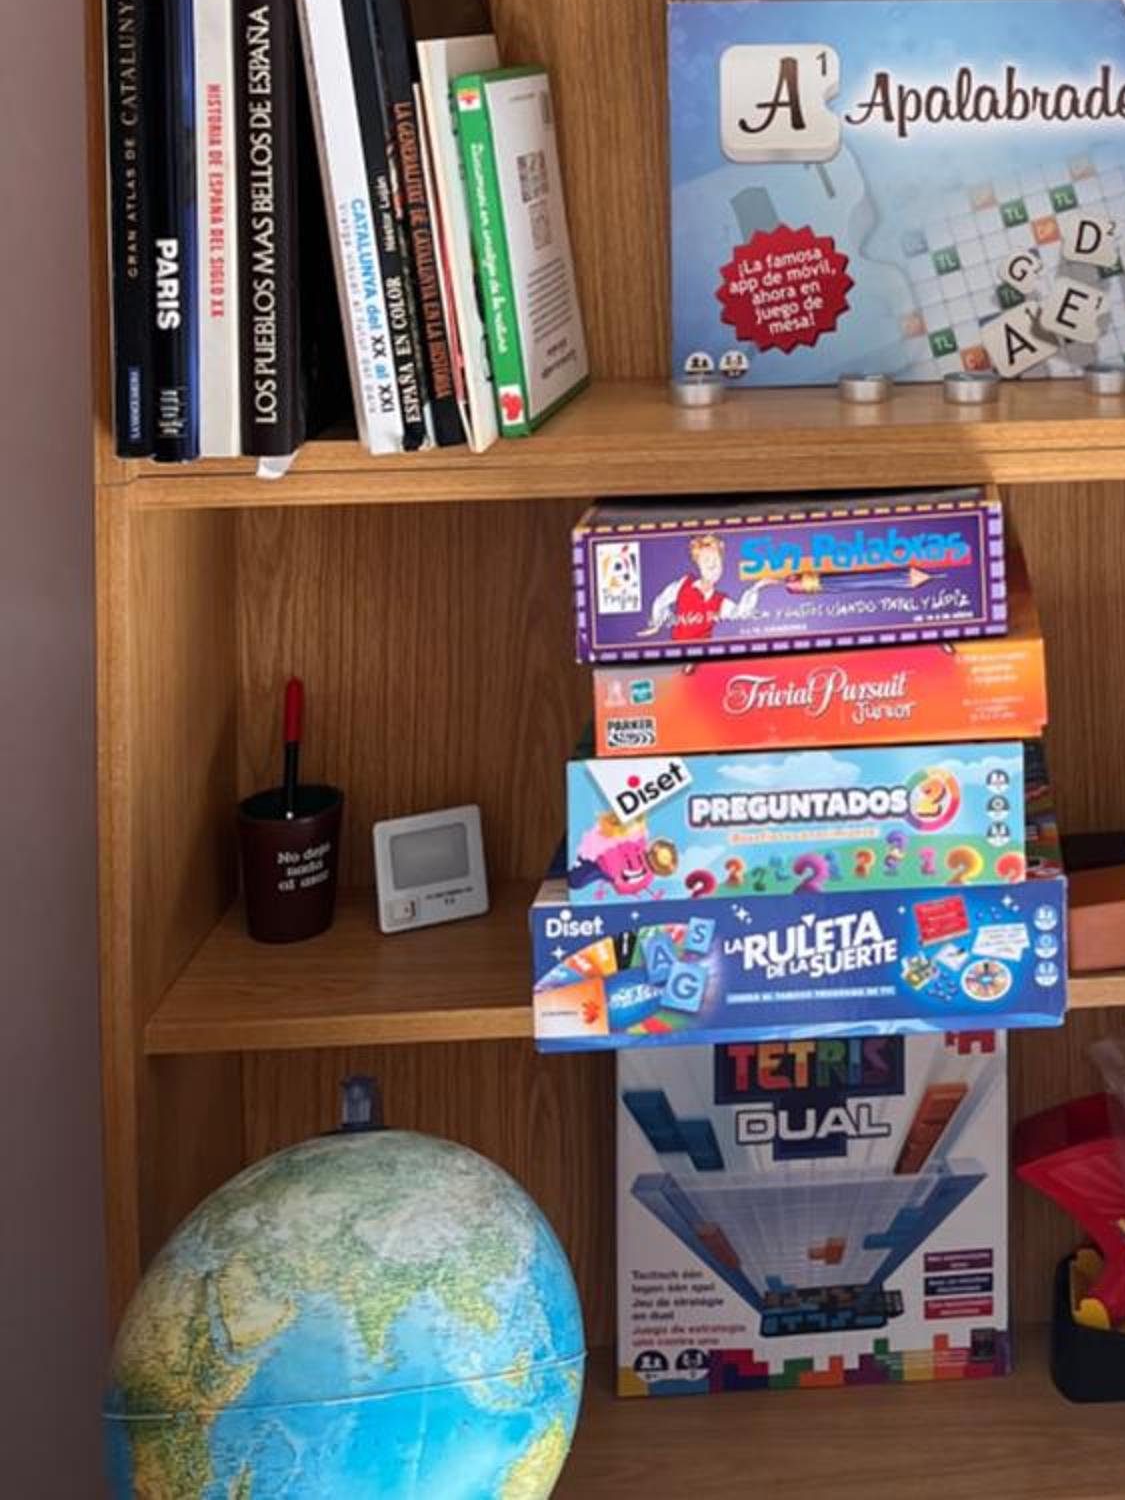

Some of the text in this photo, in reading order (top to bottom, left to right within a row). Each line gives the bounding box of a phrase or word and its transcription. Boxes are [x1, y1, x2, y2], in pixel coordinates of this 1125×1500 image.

[738, 52, 830, 134] A 1
[125, 137, 138, 278] GRAN ATLAS DE
[207, 84, 225, 318] HISTORIA DE DEL SIGLO XX
[246, 4, 277, 425] LOS PUEBLOS MAS BELLOS DE ESPAÑA
[396, 121, 425, 205] GENERALITAT
[412, 228, 442, 302] CATALUNYA
[765, 247, 823, 270] famosa
[1073, 219, 1103, 255] D
[156, 236, 179, 332] PARIS
[728, 259, 837, 297] app de móvil,
[1007, 254, 1033, 283] G
[350, 197, 395, 413] CATALUNYA del XX al XXI
[751, 280, 821, 306] ahora en
[754, 295, 824, 326] juego de
[1056, 287, 1090, 330] E
[768, 310, 817, 336] mesa!
[1002, 322, 1038, 366] A
[385, 274, 421, 424] ESPAÑA EN COLOR
[739, 527, 973, 575] Sin Palabras
[723, 672, 818, 715] Trivial
[803, 665, 914, 718] Pursuit
[851, 701, 916, 725] Junior
[615, 760, 686, 815] Diset
[690, 779, 948, 823] PREGUNTADOS 2
[545, 909, 604, 938] Diset
[690, 924, 706, 946] S
[723, 910, 884, 971] LA RULETA
[651, 943, 674, 972] A
[766, 938, 898, 980] DE LA SUERTE
[671, 973, 699, 1000] G
[727, 1036, 888, 1093] TETRIS
[735, 1103, 892, 1146] DUAL
